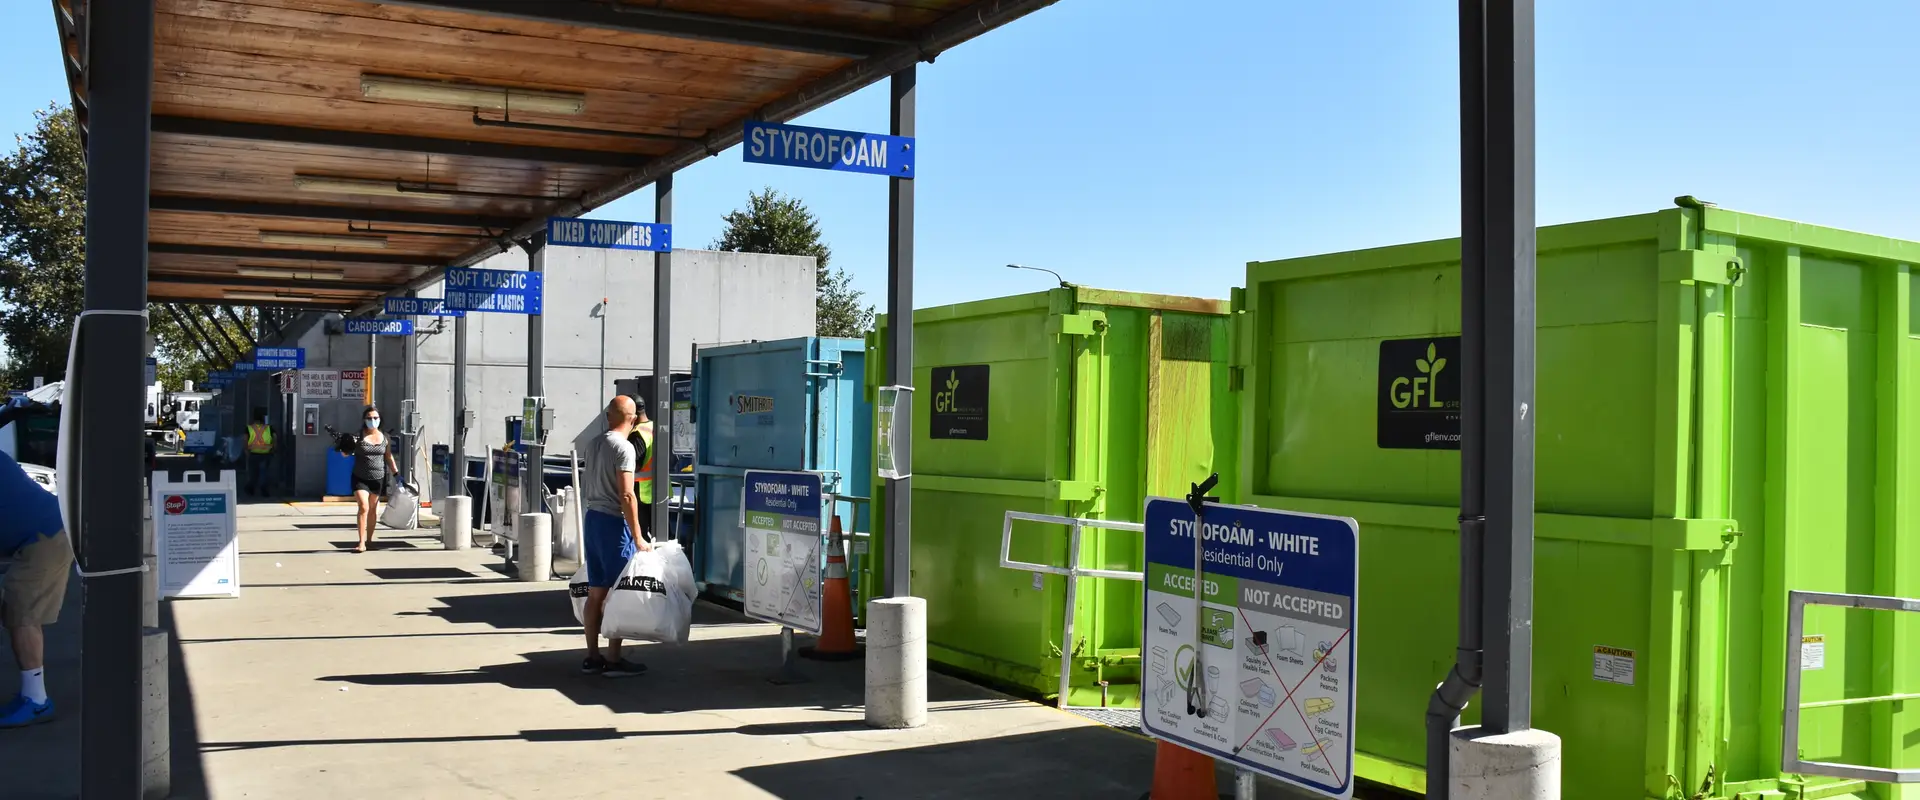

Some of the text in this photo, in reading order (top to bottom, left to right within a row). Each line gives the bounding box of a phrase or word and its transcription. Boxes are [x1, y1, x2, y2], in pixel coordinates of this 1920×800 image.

[751, 126, 887, 168] STYROFOAM
[553, 220, 652, 247] MIXED CONTAINERS
[449, 270, 527, 289] SOFT PLASTIC
[388, 300, 452, 314] MIXED PAPE
[447, 292, 524, 311] OTHER FLEXIBLE PLASTICS
[348, 321, 402, 333] CARDBOARD
[1390, 370, 1444, 408] GFL
[936, 386, 958, 412] GFL
[754, 482, 787, 494] STYROFOAM
[791, 485, 809, 496] WHITE
[765, 497, 797, 511] Residential Only
[752, 516, 774, 526] ACCEPTED
[783, 520, 817, 532] NOT ACCEPTED
[1170, 518, 1254, 546] STYOFOAM
[1268, 531, 1319, 556] WHITE
[1257, 555, 1284, 577] Only
[1163, 572, 1219, 595] ACCEPED
[1244, 588, 1343, 619] NOT ACCEPTED
[1602, 647, 1632, 657] CAUTION
[1245, 656, 1261, 665] Squishy
[1276, 654, 1303, 666] Foam Sheets
[1243, 663, 1270, 675] Flexible Foam
[1320, 674, 1338, 685] Packing
[1320, 683, 1338, 692] Peanuts
[1240, 699, 1258, 709] Coloured
[1238, 706, 1260, 718] Foam Trays
[1318, 718, 1339, 728] Coloured
[1314, 725, 1342, 738] Egg Cartons
[1246, 744, 1285, 761] Construction Foam
[1300, 761, 1330, 776] Pool Noodles
